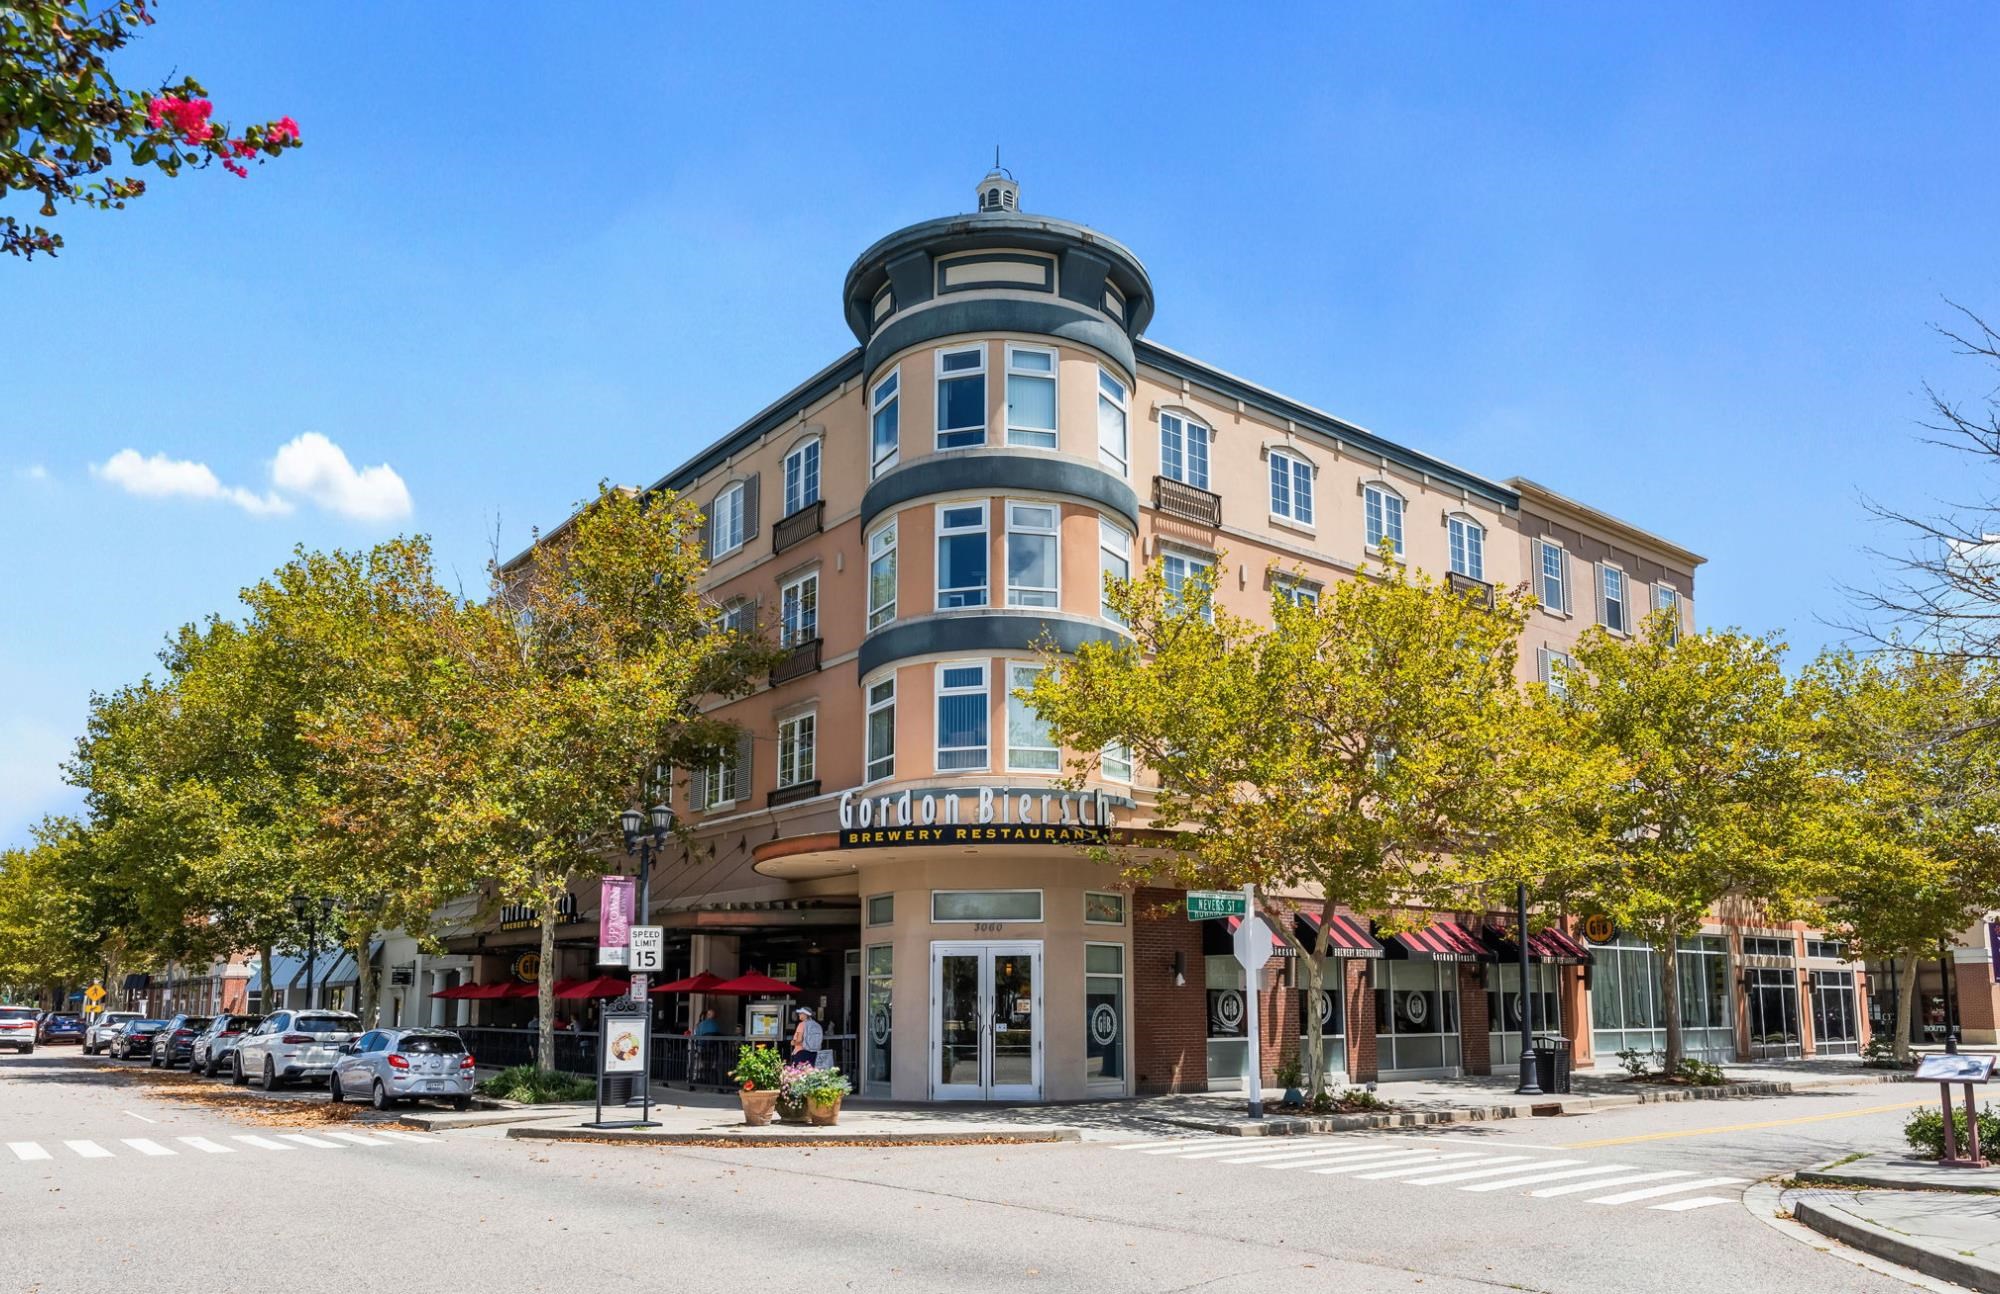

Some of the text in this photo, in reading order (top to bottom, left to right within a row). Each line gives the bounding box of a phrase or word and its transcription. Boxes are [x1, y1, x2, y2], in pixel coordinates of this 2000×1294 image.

[838, 785, 1110, 830] Gordon Biersch
[849, 828, 1099, 844] BREWERY RESTAURANT
[1198, 898, 1236, 912] NEVERS ST
[607, 885, 621, 944] UPTOWN
[632, 930, 660, 938] SPEED
[635, 939, 657, 947] LIMIT
[636, 951, 656, 967] 15
[1334, 947, 1355, 957] BREWERY
